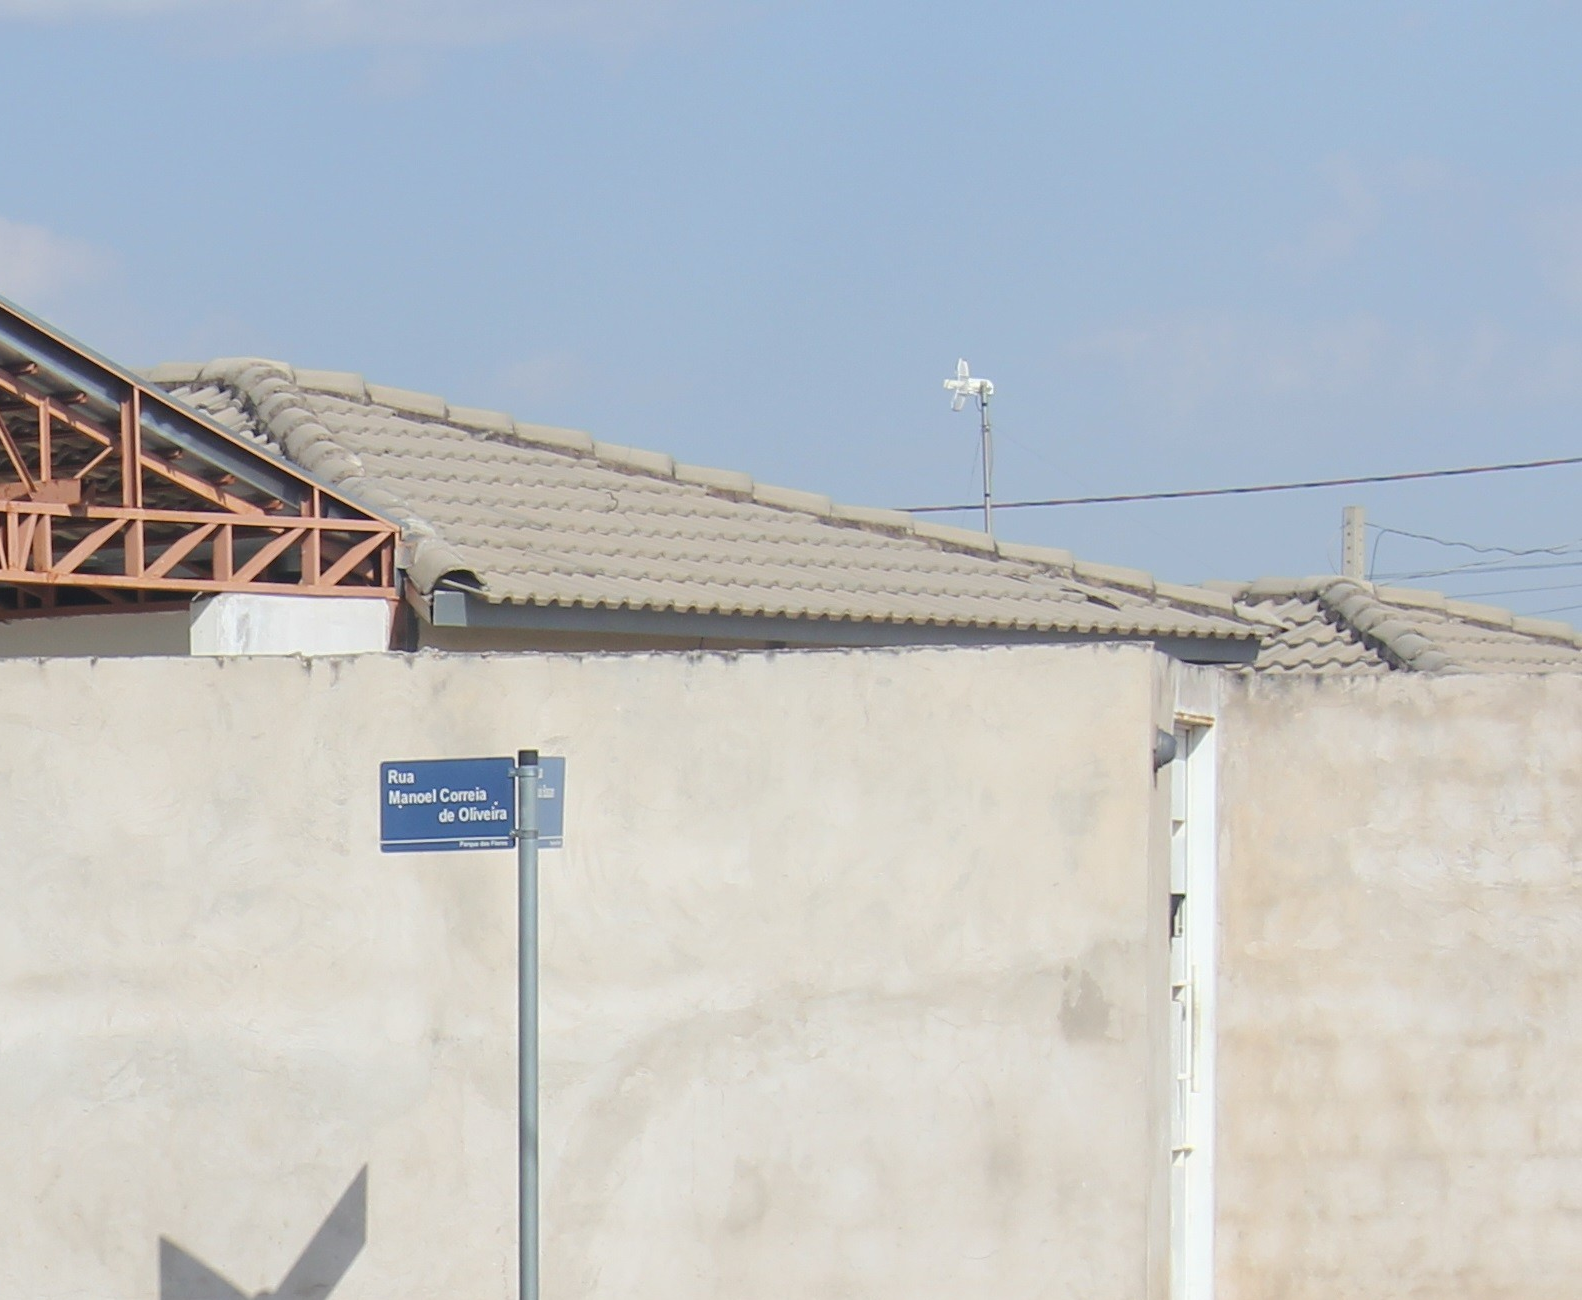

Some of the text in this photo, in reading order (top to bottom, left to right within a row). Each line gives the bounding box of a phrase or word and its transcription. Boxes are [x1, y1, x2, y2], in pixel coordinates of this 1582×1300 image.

[387, 769, 415, 784] Rua
[388, 787, 487, 805] Manoel Correia
[438, 806, 508, 823] de Oliveira
